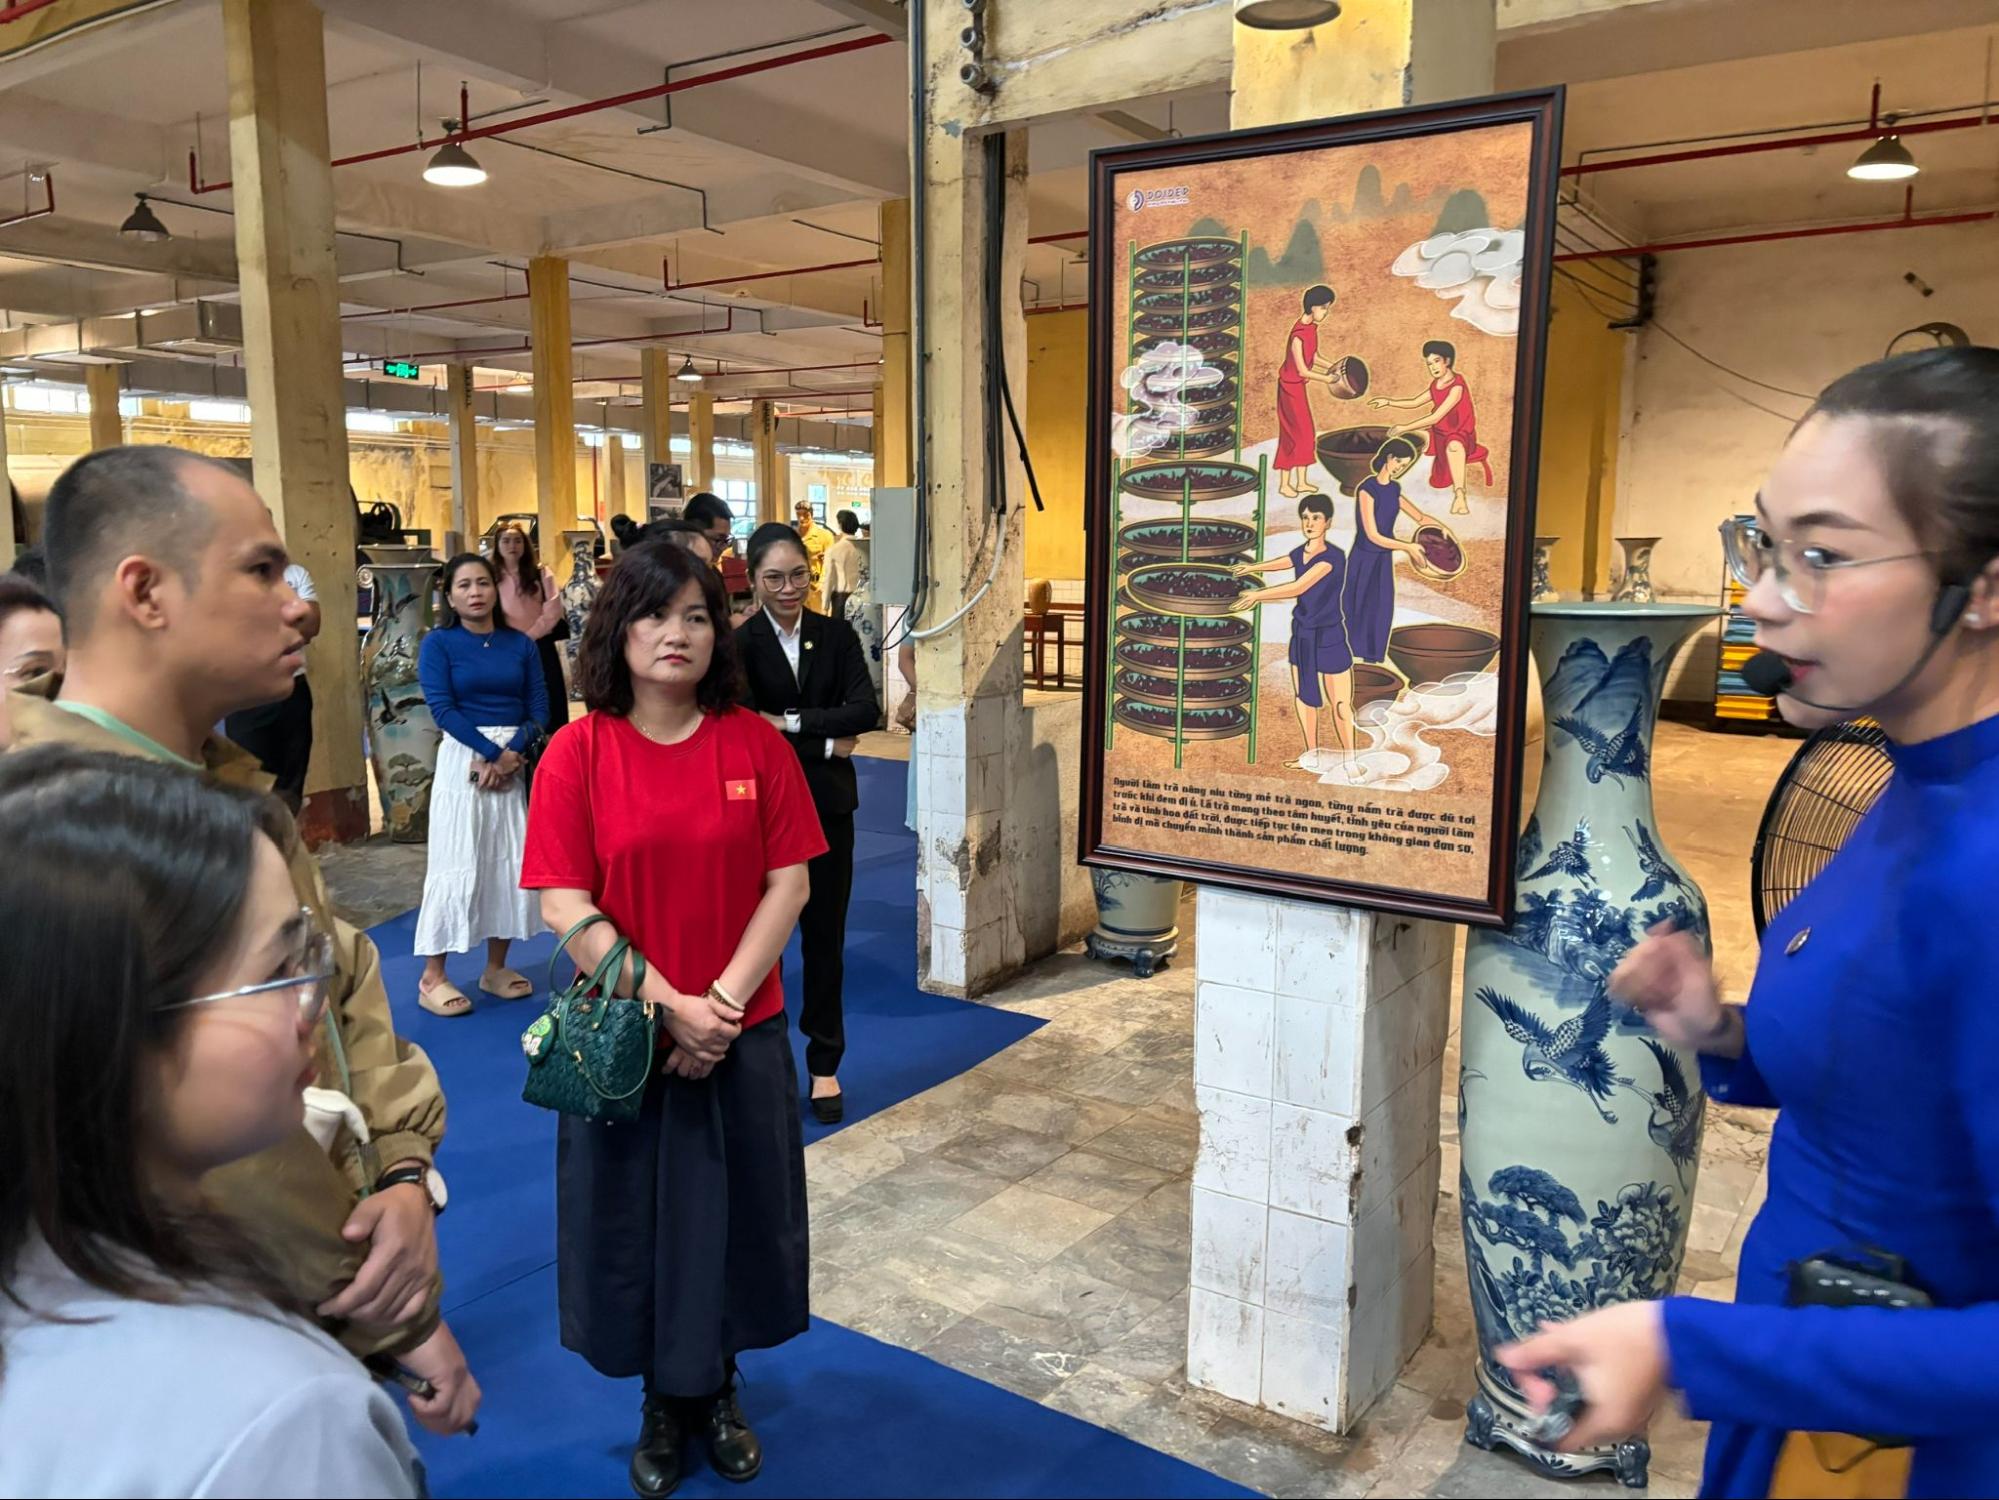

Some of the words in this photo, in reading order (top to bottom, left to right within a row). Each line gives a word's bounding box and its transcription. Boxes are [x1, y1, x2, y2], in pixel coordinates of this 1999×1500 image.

[1140, 792, 1154, 801] khi
[1157, 794, 1176, 804] đem
[1214, 801, 1229, 810] trà
[1232, 805, 1259, 815] mang
[1262, 807, 1285, 816] theo
[1288, 810, 1308, 819] tâm
[1347, 814, 1368, 826] tình
[1371, 819, 1391, 829] yêu
[1394, 821, 1413, 832] của
[1452, 827, 1474, 838] làm
[1142, 780, 1160, 789] làm
[1164, 783, 1178, 791] trà
[1210, 788, 1225, 796] niu
[1229, 789, 1252, 801] từng
[1276, 795, 1291, 804] trà
[1296, 798, 1324, 808] ngon,
[1328, 800, 1353, 813] từng
[1386, 808, 1403, 816] trà
[1408, 809, 1435, 821] được
[1113, 802, 1126, 810] trà
[1130, 804, 1140, 812] và
[1163, 808, 1180, 817] hoa
[1224, 815, 1248, 826] được
[1251, 818, 1270, 829] tiếp
[1273, 821, 1289, 831] tục
[1292, 822, 1307, 832] lên
[1311, 827, 1333, 835] men
[1336, 829, 1365, 841] trong
[1368, 832, 1403, 845] không
[1406, 838, 1430, 847] gian
[1145, 819, 1159, 827] mà
[1199, 824, 1222, 835] mình
[1225, 828, 1253, 838] thành
